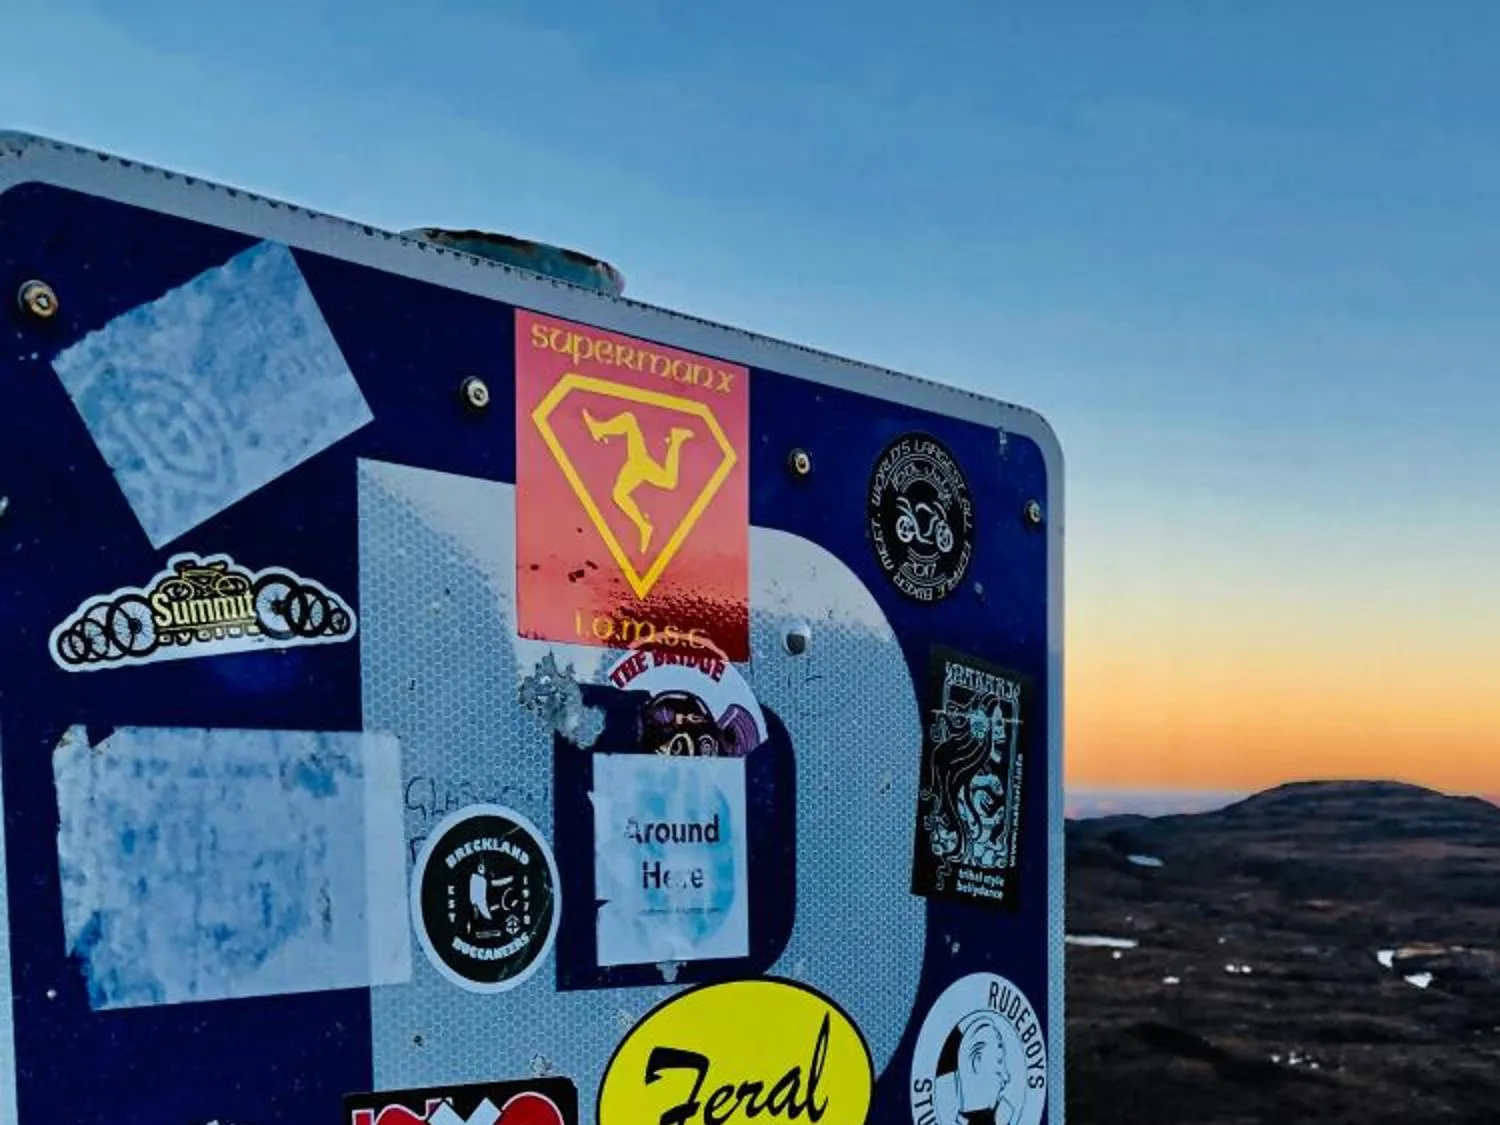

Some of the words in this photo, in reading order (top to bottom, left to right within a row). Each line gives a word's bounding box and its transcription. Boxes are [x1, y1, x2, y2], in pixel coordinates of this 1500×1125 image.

[151, 589, 258, 628] Summit
[609, 650, 649, 689] THE
[642, 860, 704, 889] Hee
[987, 981, 1045, 1089] RUDEBOYS
